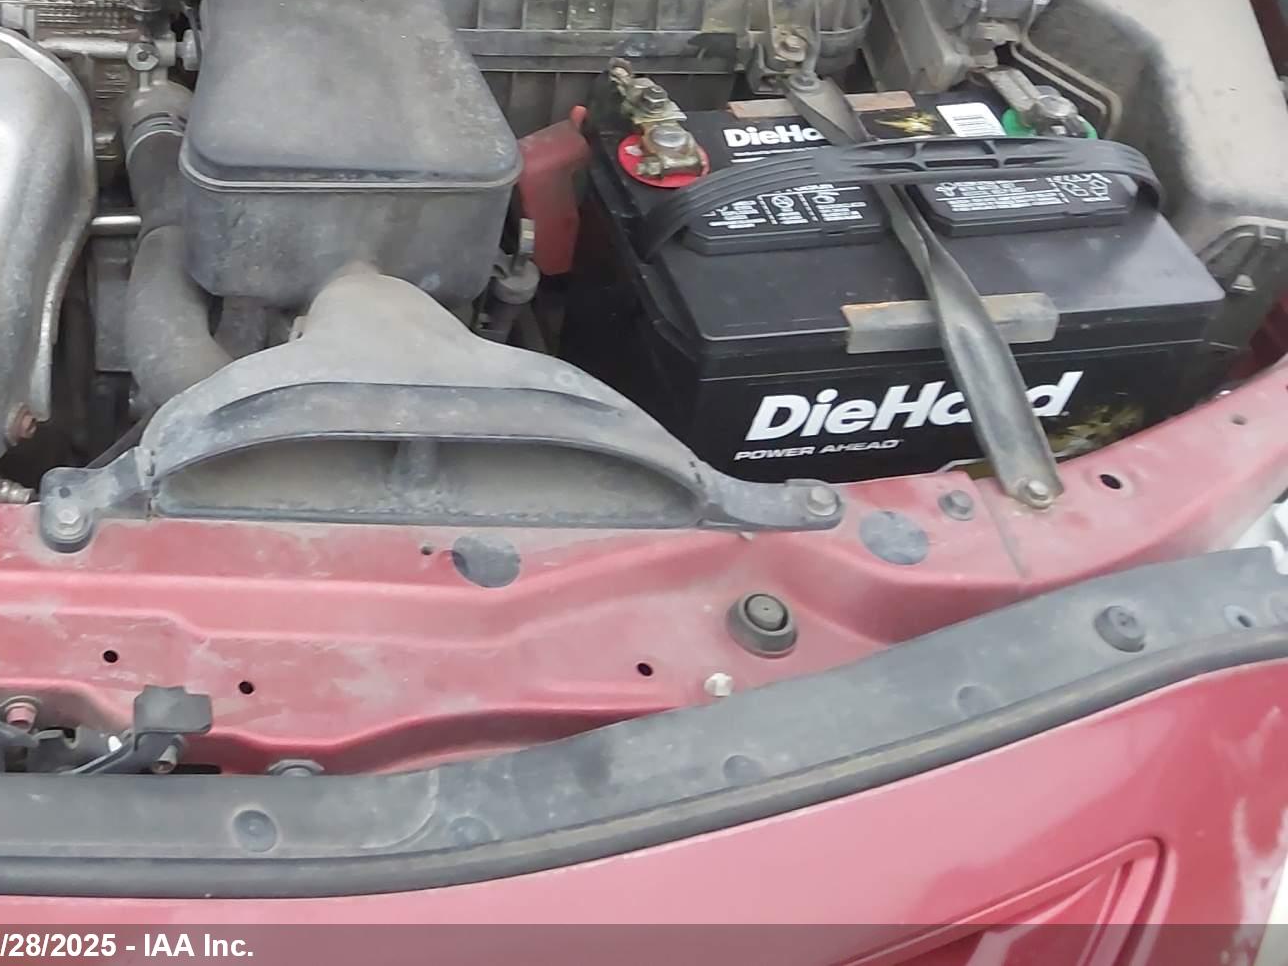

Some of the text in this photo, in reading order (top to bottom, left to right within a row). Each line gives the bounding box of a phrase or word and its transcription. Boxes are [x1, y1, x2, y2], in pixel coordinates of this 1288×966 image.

[723, 124, 825, 148] DieHa
[745, 371, 1084, 441] DieHad
[734, 446, 816, 461] POWER
